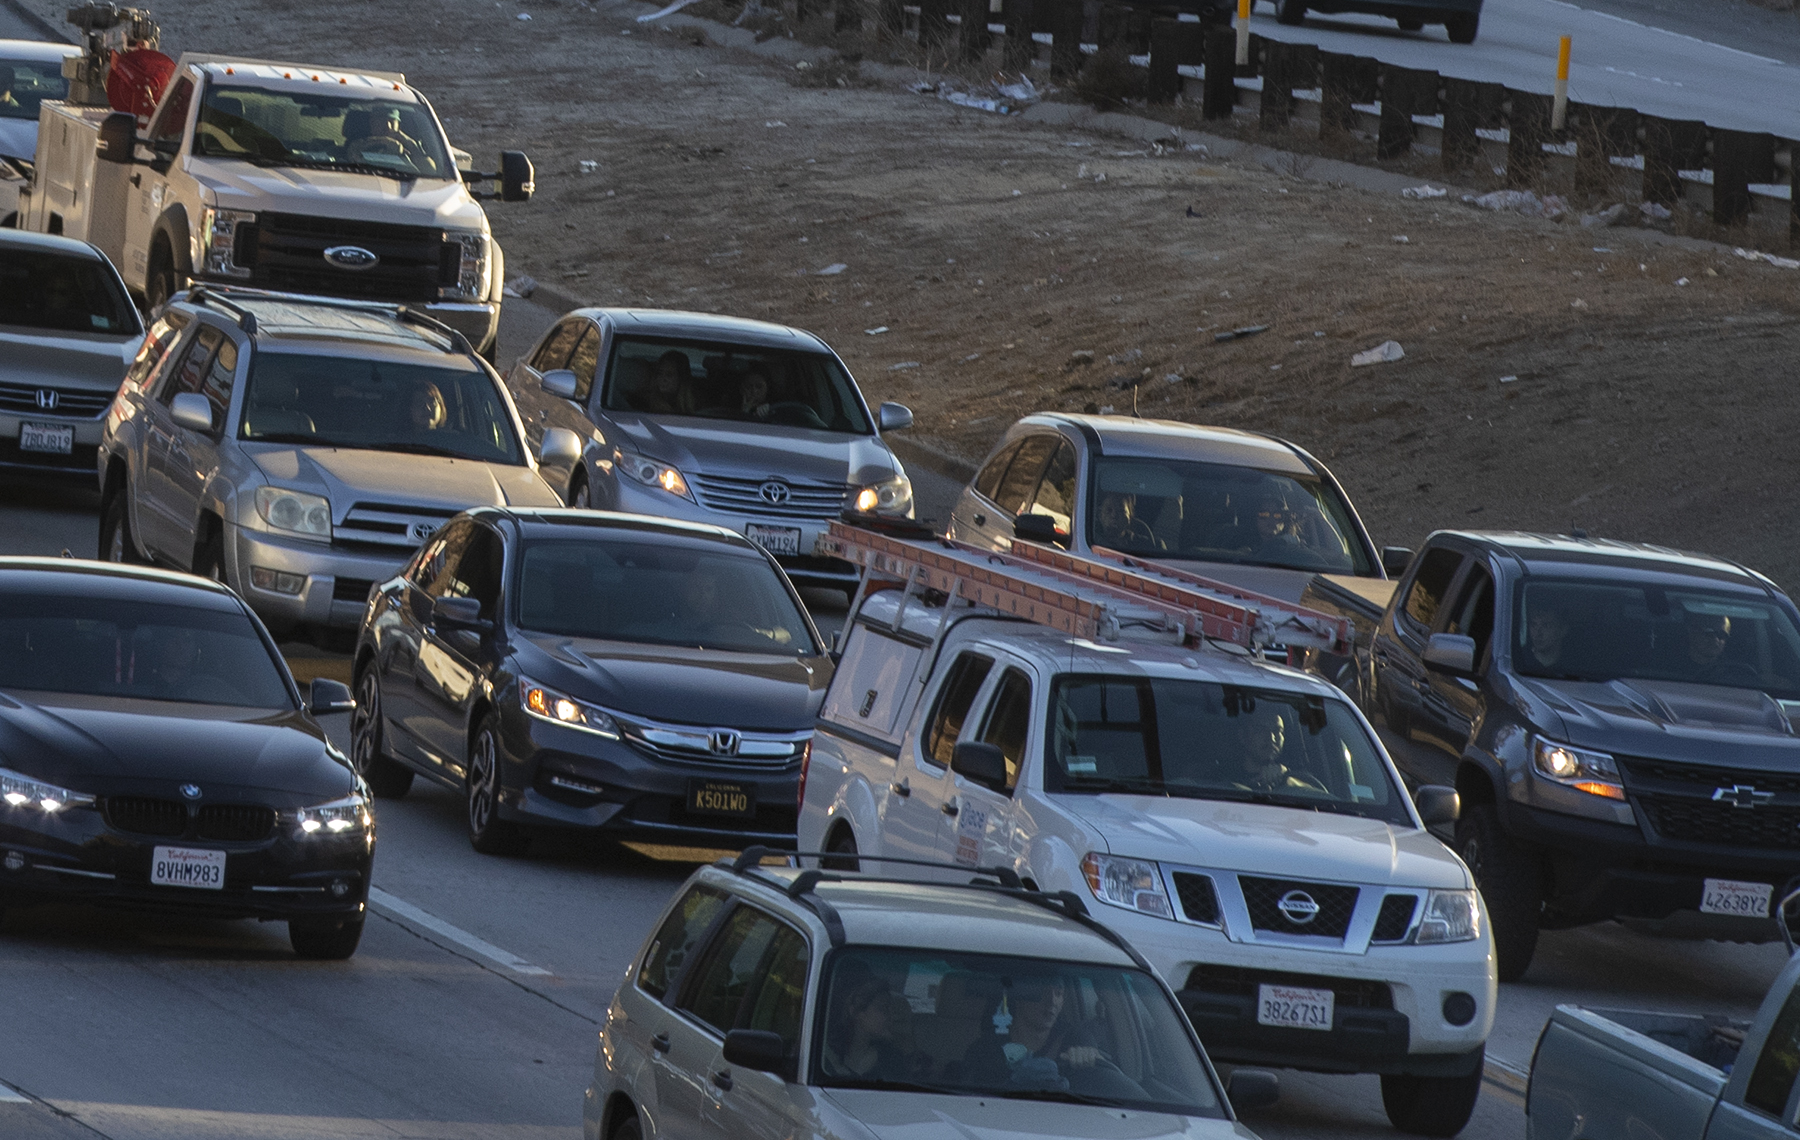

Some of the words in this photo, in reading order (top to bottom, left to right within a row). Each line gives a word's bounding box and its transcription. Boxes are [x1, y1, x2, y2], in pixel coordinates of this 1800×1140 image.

[157, 861, 220, 883] 8VHM983
[1706, 892, 1767, 915] 42638Y2
[1263, 1000, 1327, 1024] 38267S1
